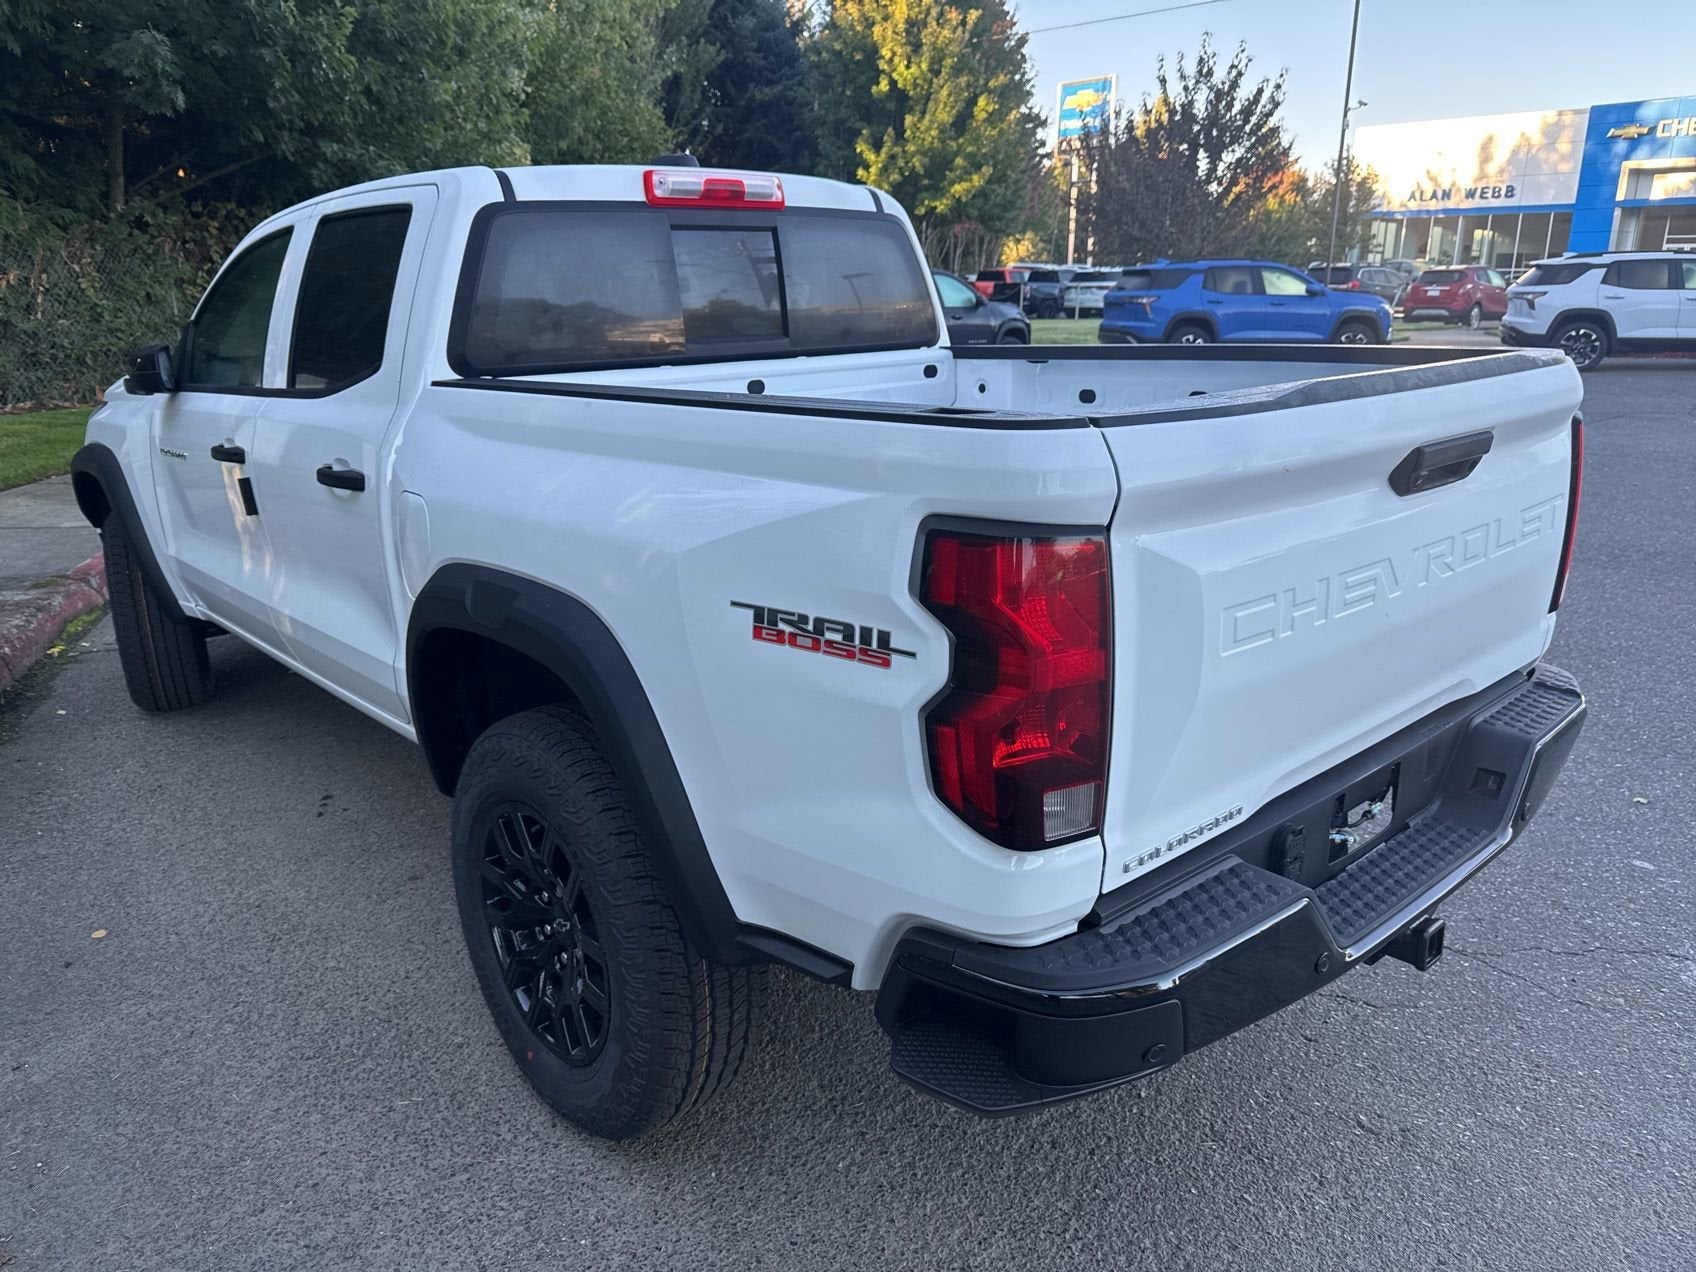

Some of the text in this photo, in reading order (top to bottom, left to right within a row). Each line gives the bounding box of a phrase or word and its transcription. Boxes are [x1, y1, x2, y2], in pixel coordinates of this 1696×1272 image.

[1407, 184, 1516, 202] ALAN WEBB
[1219, 493, 1564, 657] CHEVROLET
[730, 600, 917, 660] TRAIL
[752, 624, 892, 669] BOSS
[1122, 803, 1244, 873] COLORADO
